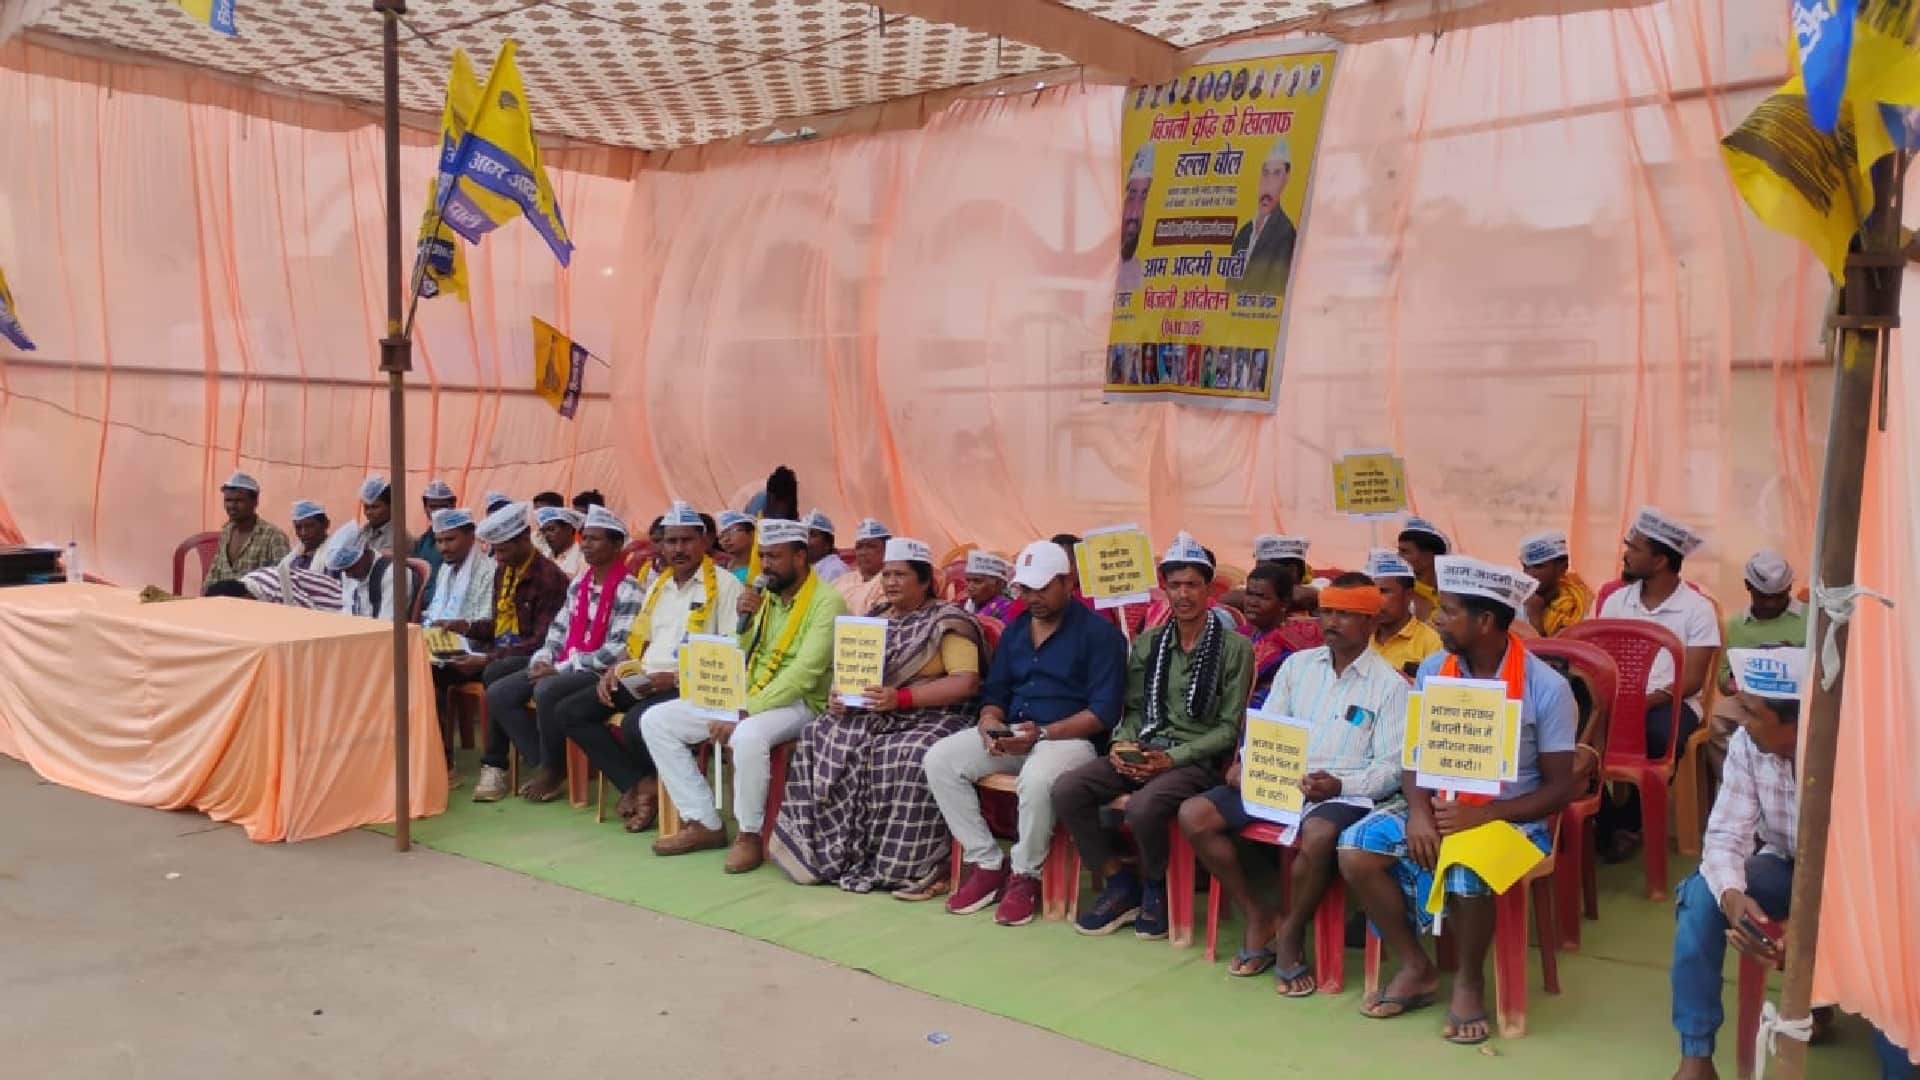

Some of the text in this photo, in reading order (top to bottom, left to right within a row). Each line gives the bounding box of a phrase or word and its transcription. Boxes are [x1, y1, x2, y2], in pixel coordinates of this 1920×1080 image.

[1151, 110, 1190, 140] बिजली
[1222, 106, 1238, 136] के
[1239, 105, 1294, 136] खिलाफ
[1174, 143, 1244, 177] हल्ला बोल
[1143, 256, 1168, 278] आम
[1172, 250, 1213, 277] आदमी
[1143, 284, 1178, 310] बिजली
[1182, 285, 1230, 311] आंदोलन
[1444, 565, 1472, 577] आम
